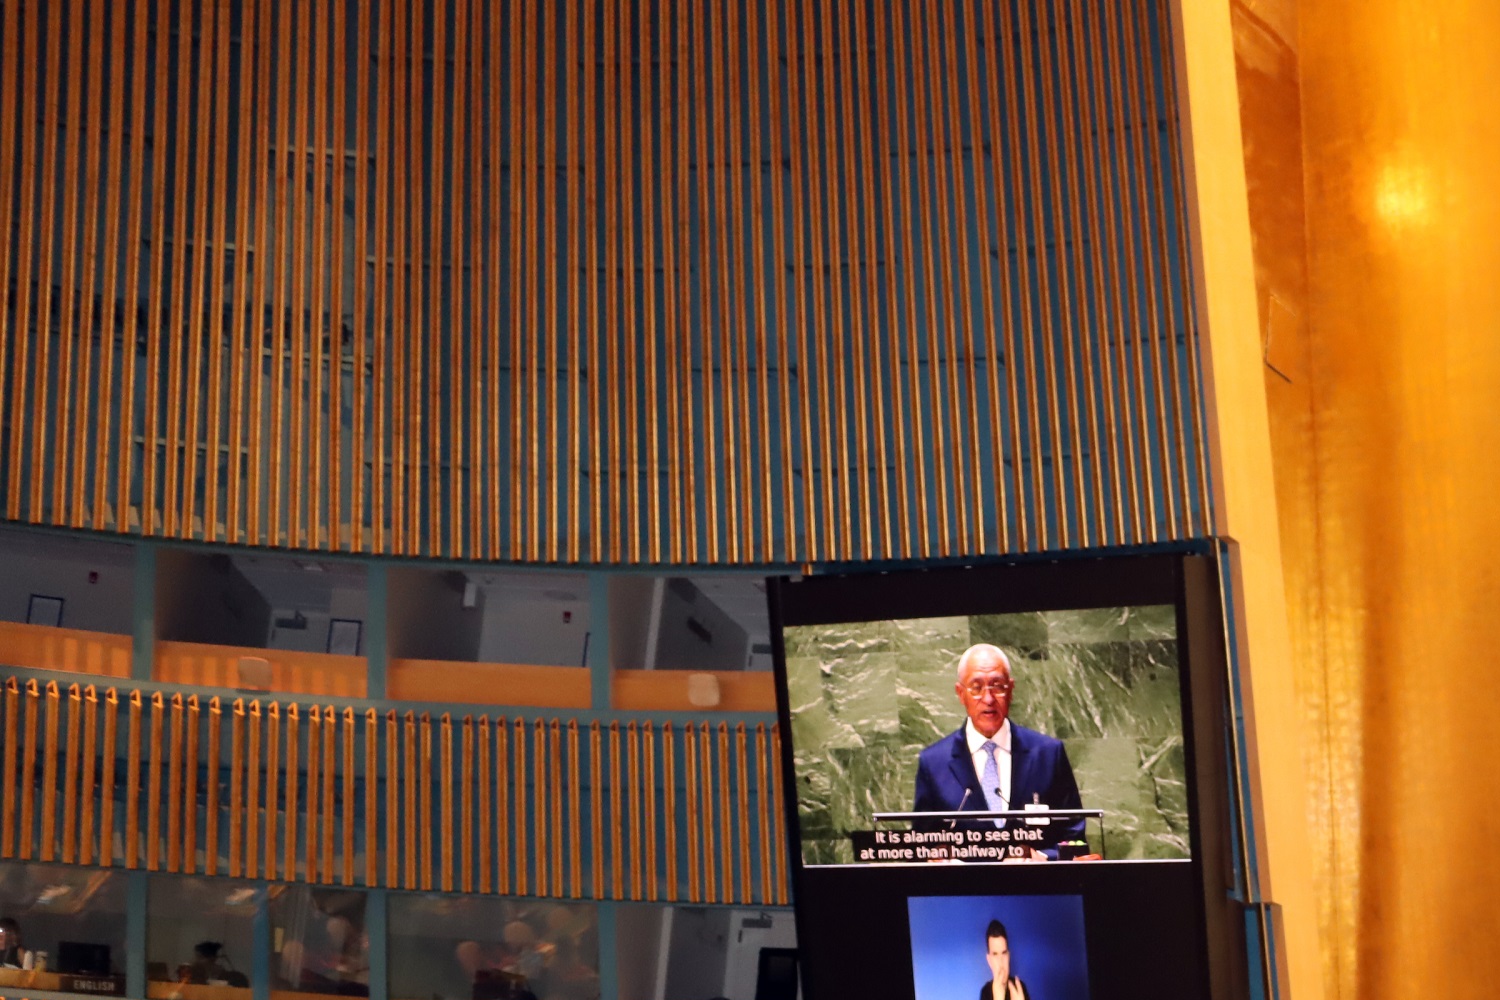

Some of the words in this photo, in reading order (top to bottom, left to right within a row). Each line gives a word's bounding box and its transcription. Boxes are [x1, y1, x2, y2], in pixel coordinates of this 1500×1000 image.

[875, 831, 886, 843] It
[888, 830, 900, 843] is
[903, 829, 964, 845] alarming
[966, 830, 982, 842] to
[984, 830, 1010, 842] see
[1012, 828, 1043, 841] that
[860, 848, 875, 859] at
[878, 848, 913, 859] more
[916, 846, 948, 859] than
[951, 845, 1005, 860] halfway
[1008, 845, 1024, 857] to
[73, 979, 115, 991] ENGLISH
